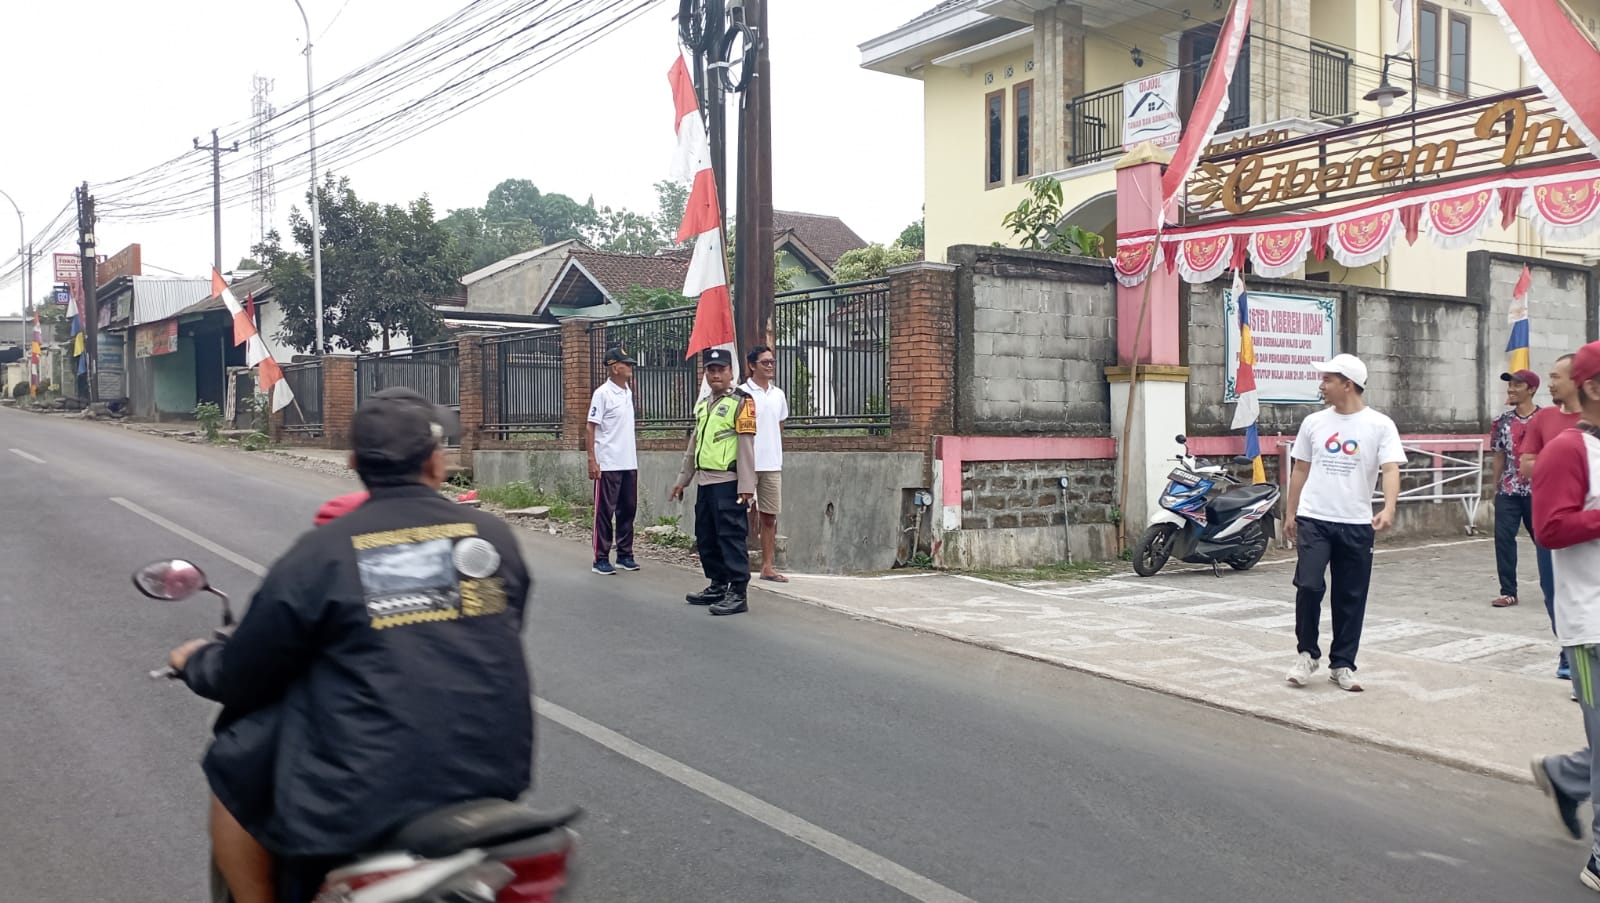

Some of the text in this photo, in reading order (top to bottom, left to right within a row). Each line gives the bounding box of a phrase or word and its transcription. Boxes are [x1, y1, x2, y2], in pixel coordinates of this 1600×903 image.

[1222, 139, 1458, 214] Ciberem
[1271, 311, 1301, 335] CIBEREM
[1302, 313, 1323, 336] INDAH
[1325, 431, 1360, 456] 60
